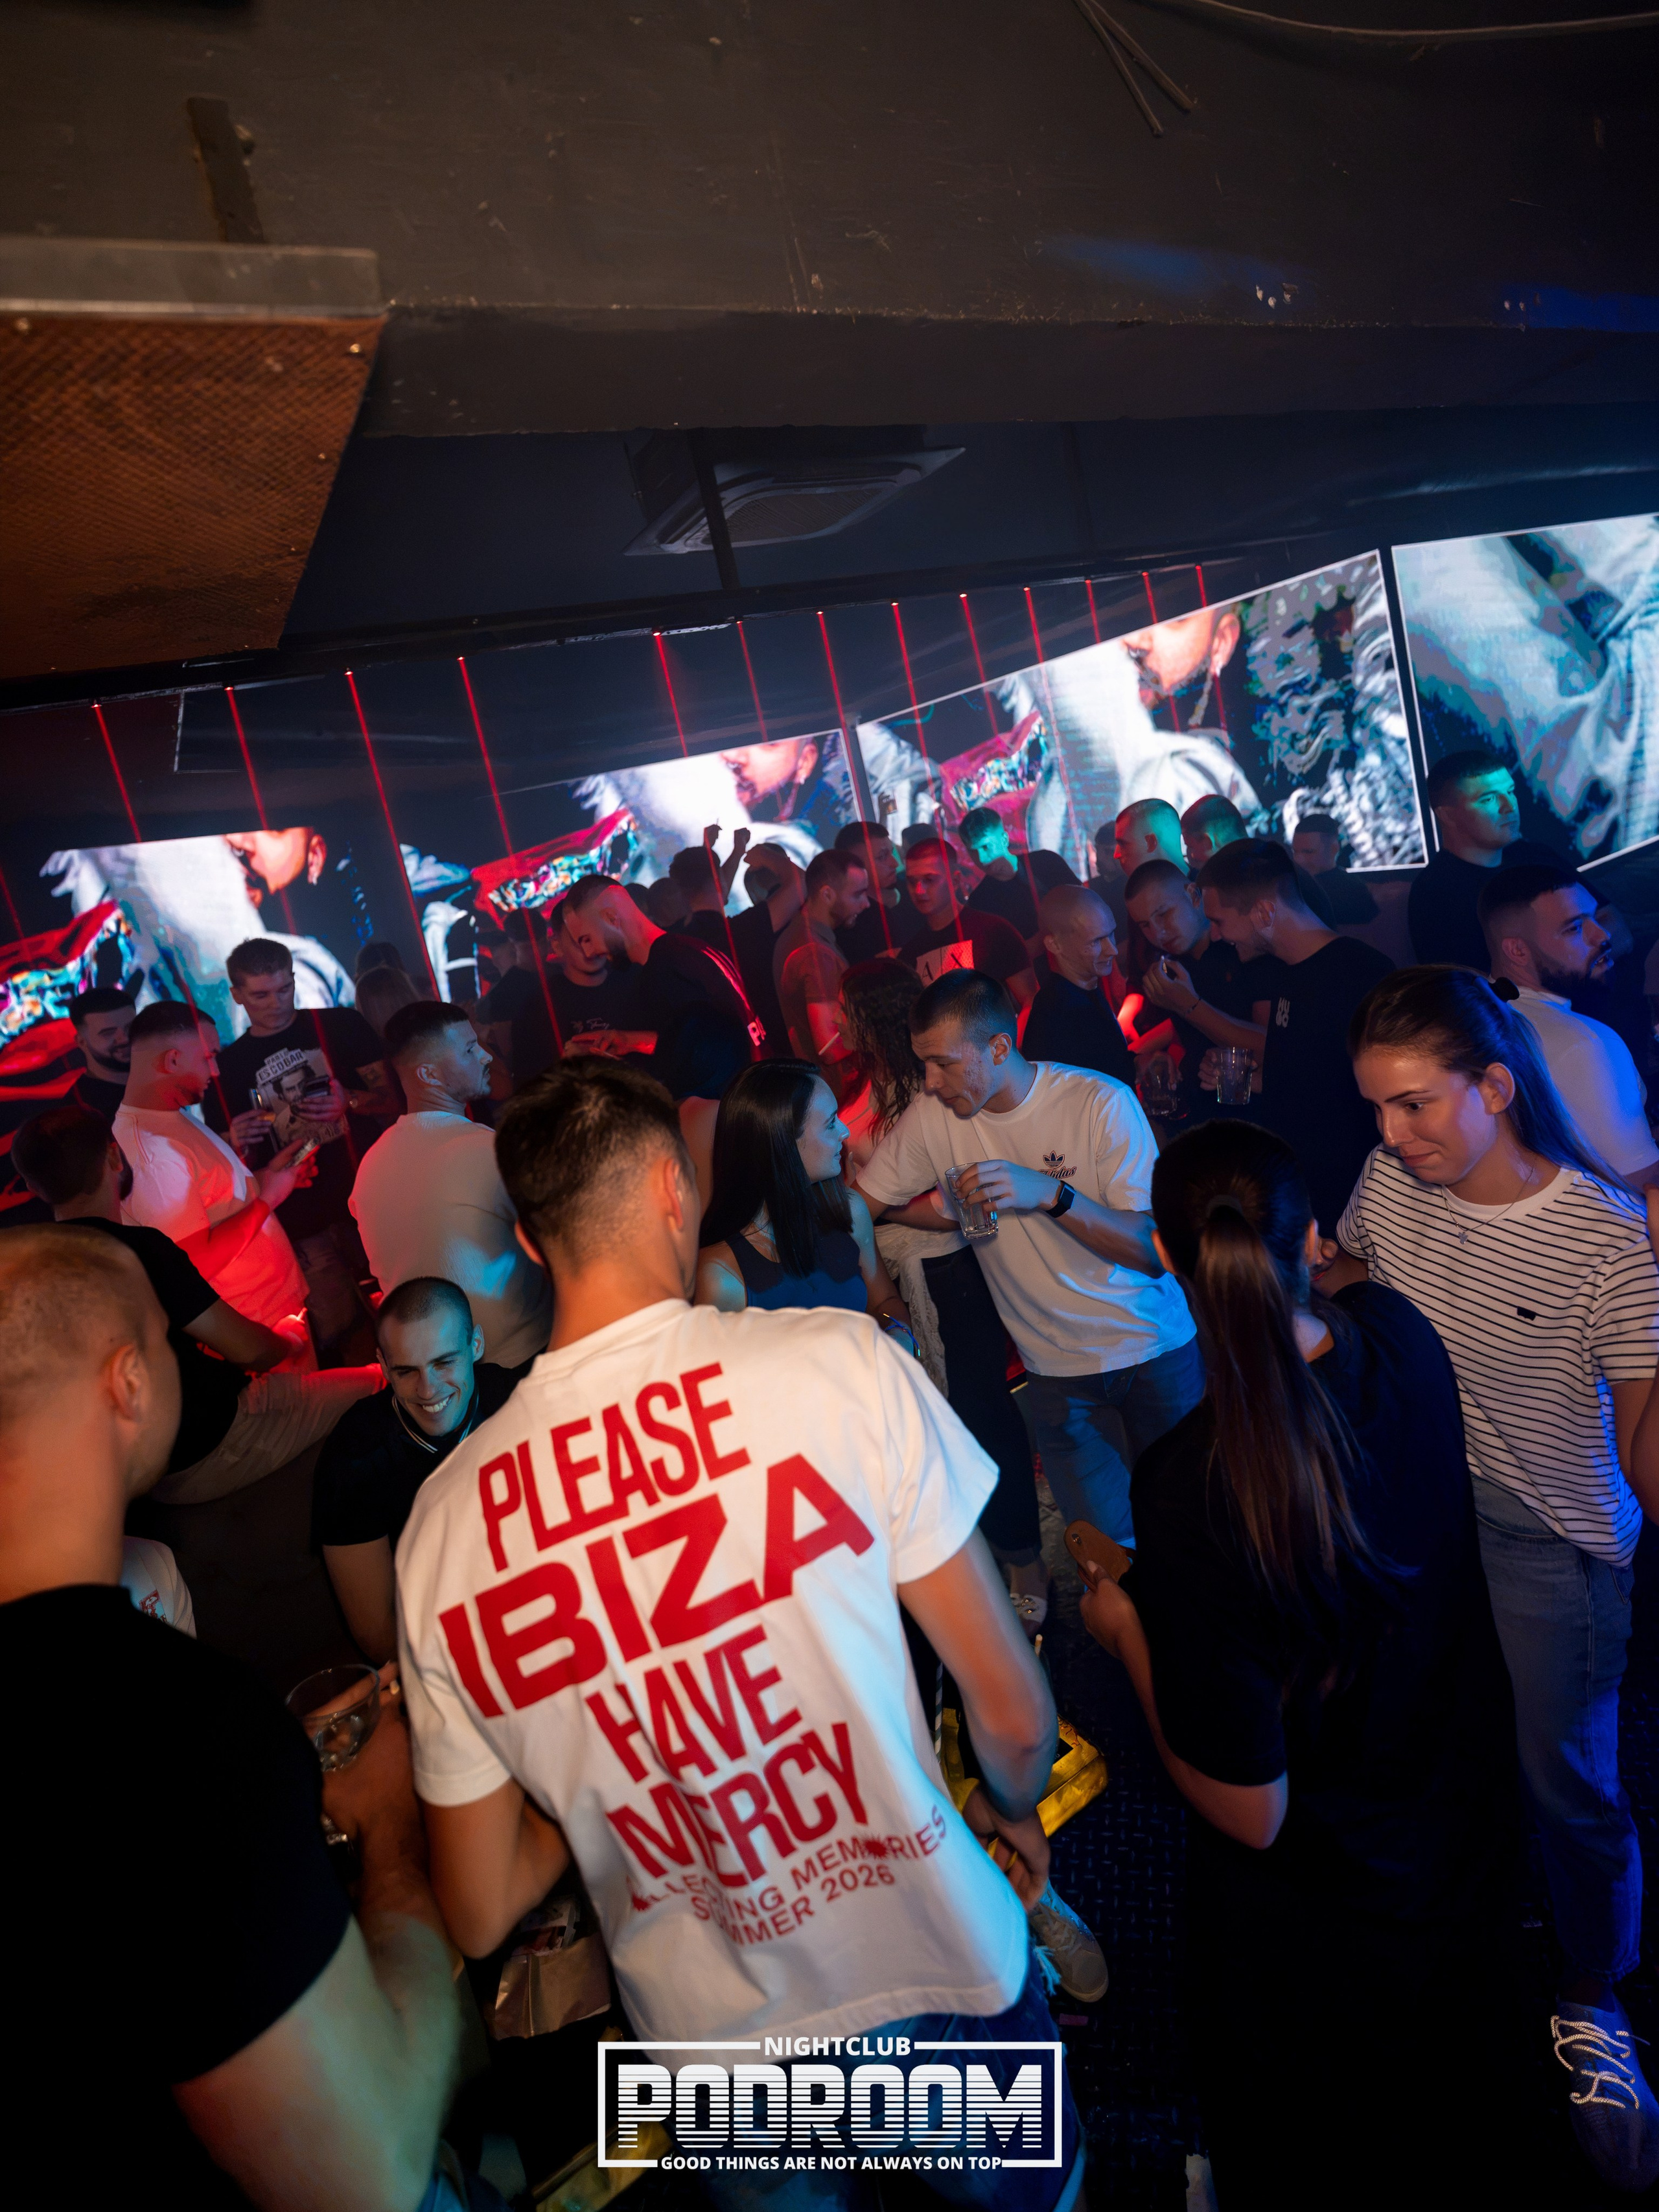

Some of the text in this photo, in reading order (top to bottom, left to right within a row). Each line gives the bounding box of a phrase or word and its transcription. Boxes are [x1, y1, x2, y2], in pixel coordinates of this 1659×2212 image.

[259, 1051, 303, 1080] ESCOBAR
[478, 1362, 750, 1573] PLEASE
[438, 1453, 876, 1719] IBIZA
[585, 1623, 804, 1784] HAVE
[606, 1721, 869, 1887] MERCY
[691, 1861, 896, 1946] SMMER 2026
